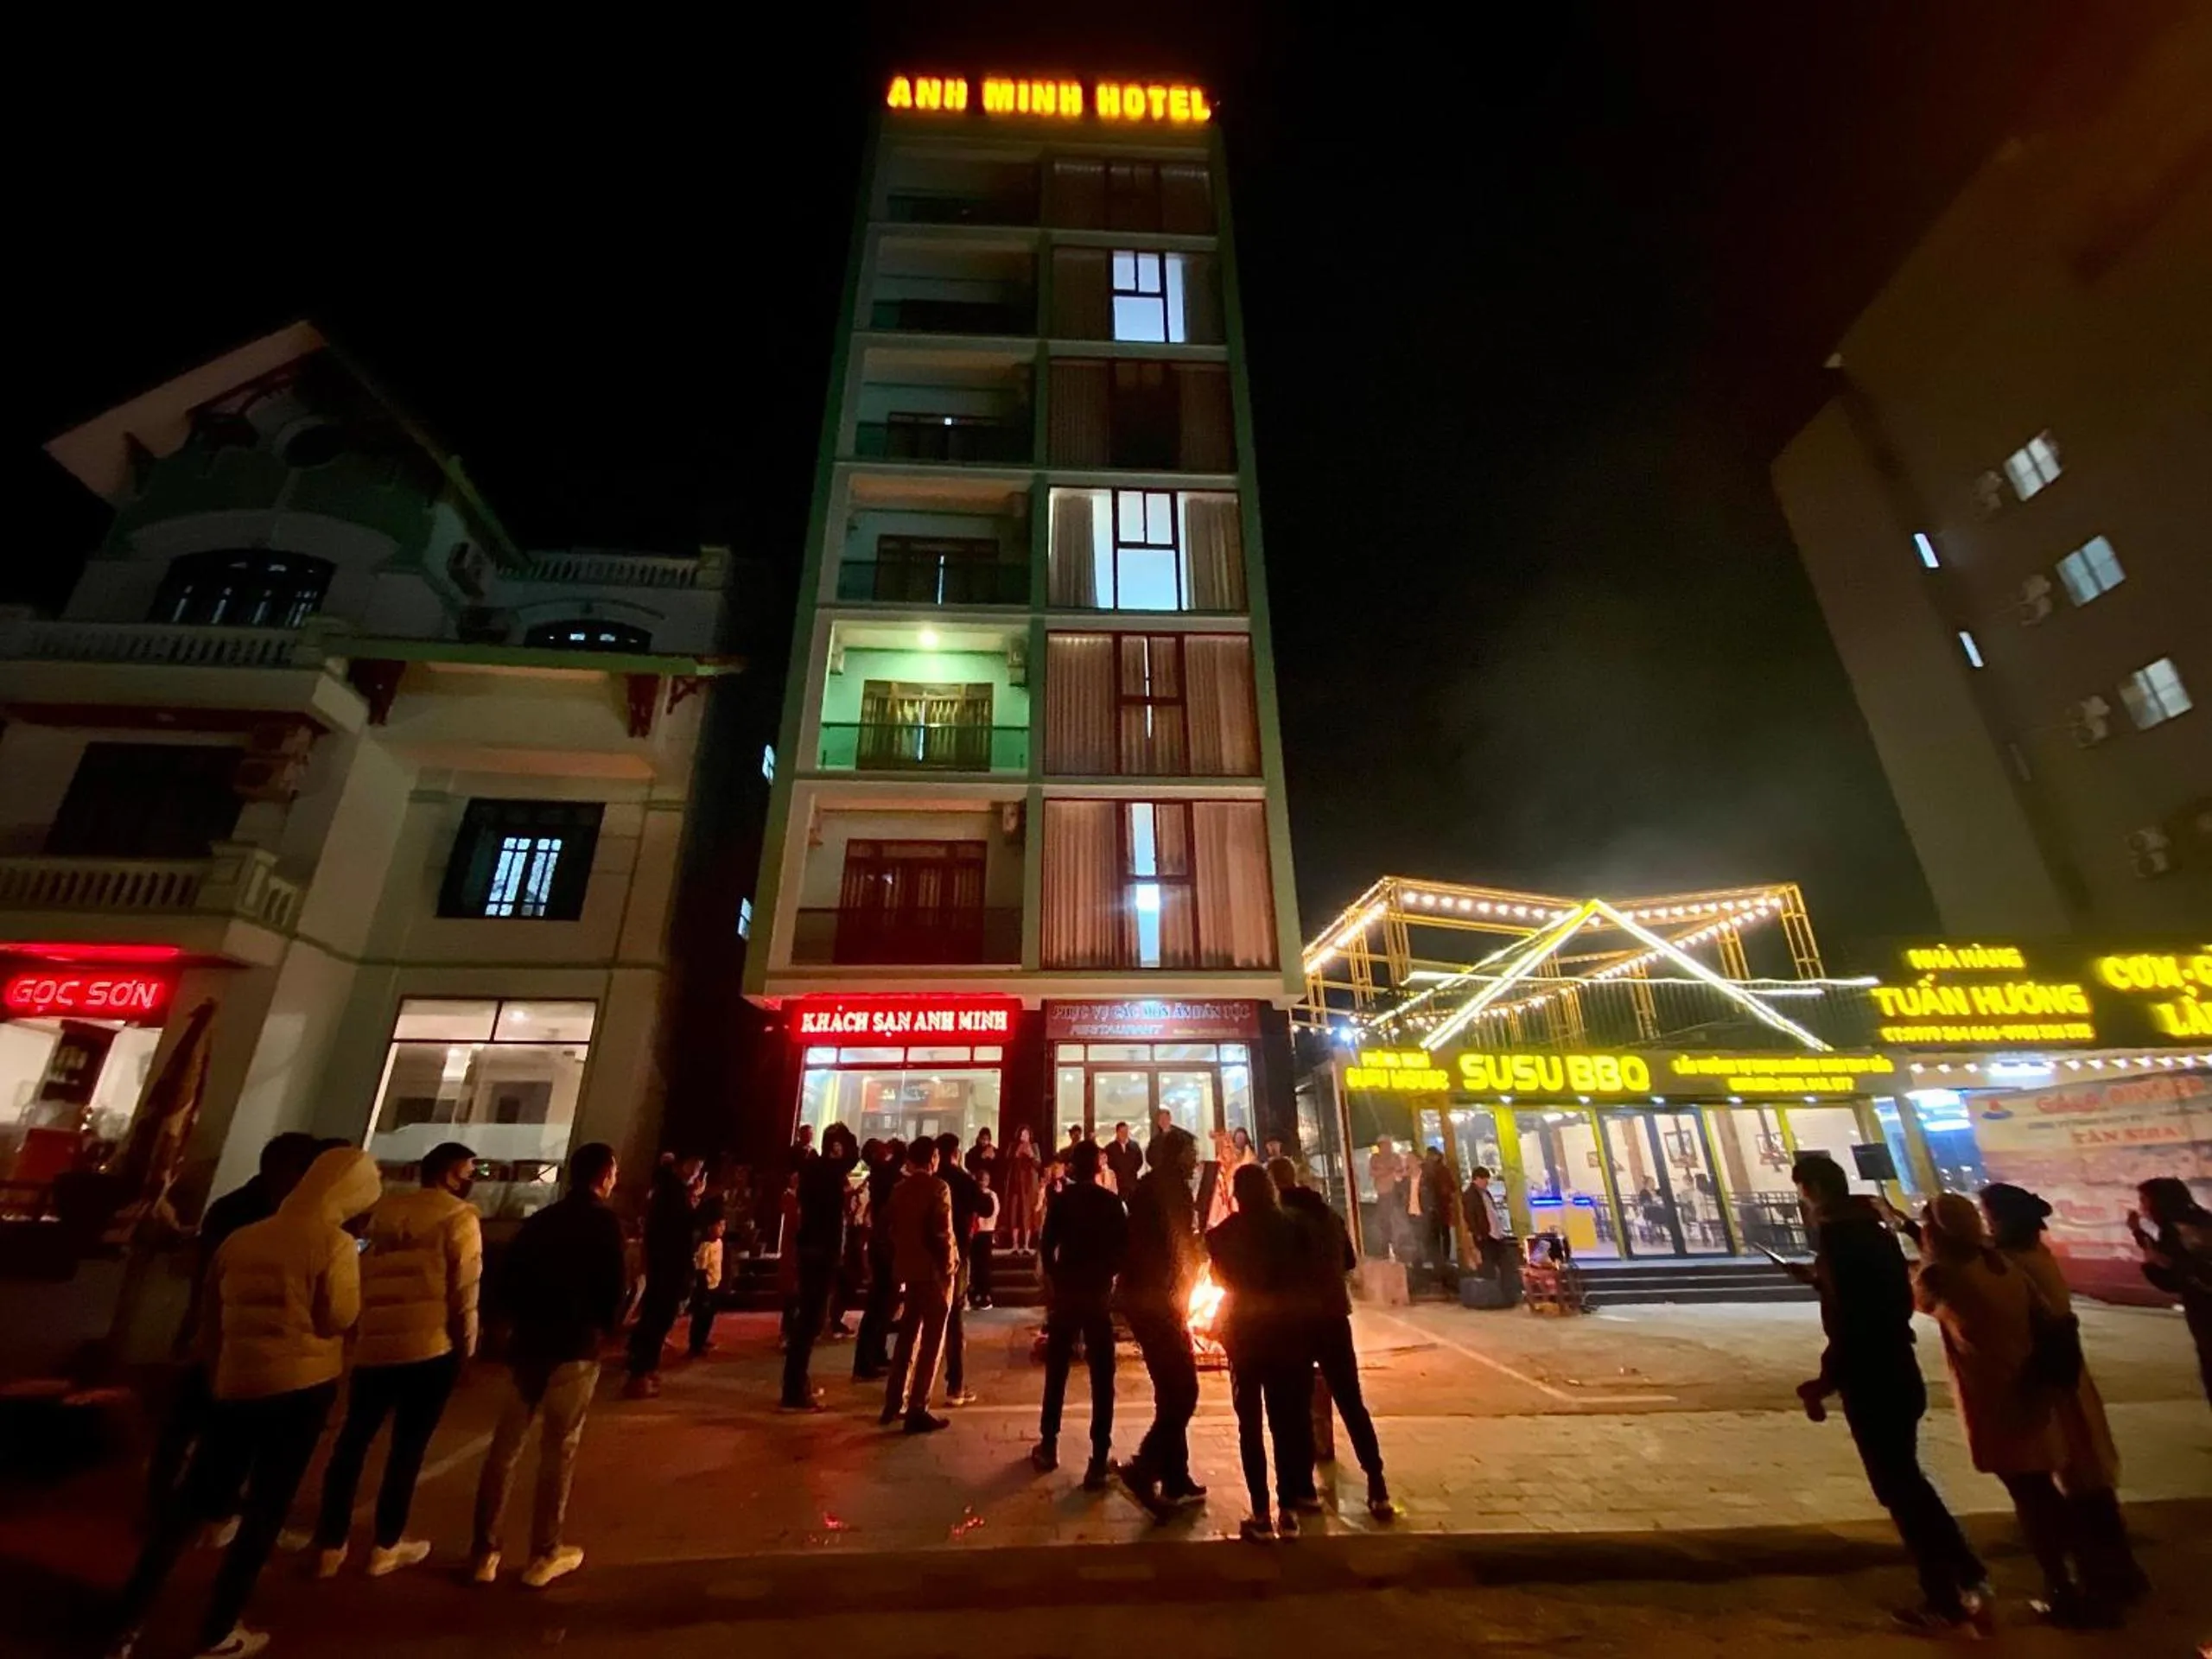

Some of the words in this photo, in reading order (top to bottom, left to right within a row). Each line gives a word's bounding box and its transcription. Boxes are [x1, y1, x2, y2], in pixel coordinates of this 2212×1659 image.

[887, 76, 968, 111] ANH
[982, 78, 1084, 118] MINH
[1096, 82, 1211, 121] HOTEL
[86, 979, 158, 1009] SƠN
[801, 1004, 869, 1033] KHÁCH
[872, 1010, 912, 1038] SẠN
[913, 1010, 955, 1032] ANH
[958, 1010, 1007, 1032] MINH
[1459, 1052, 1564, 1091] SUSU
[1566, 1054, 1651, 1092] BBQ
